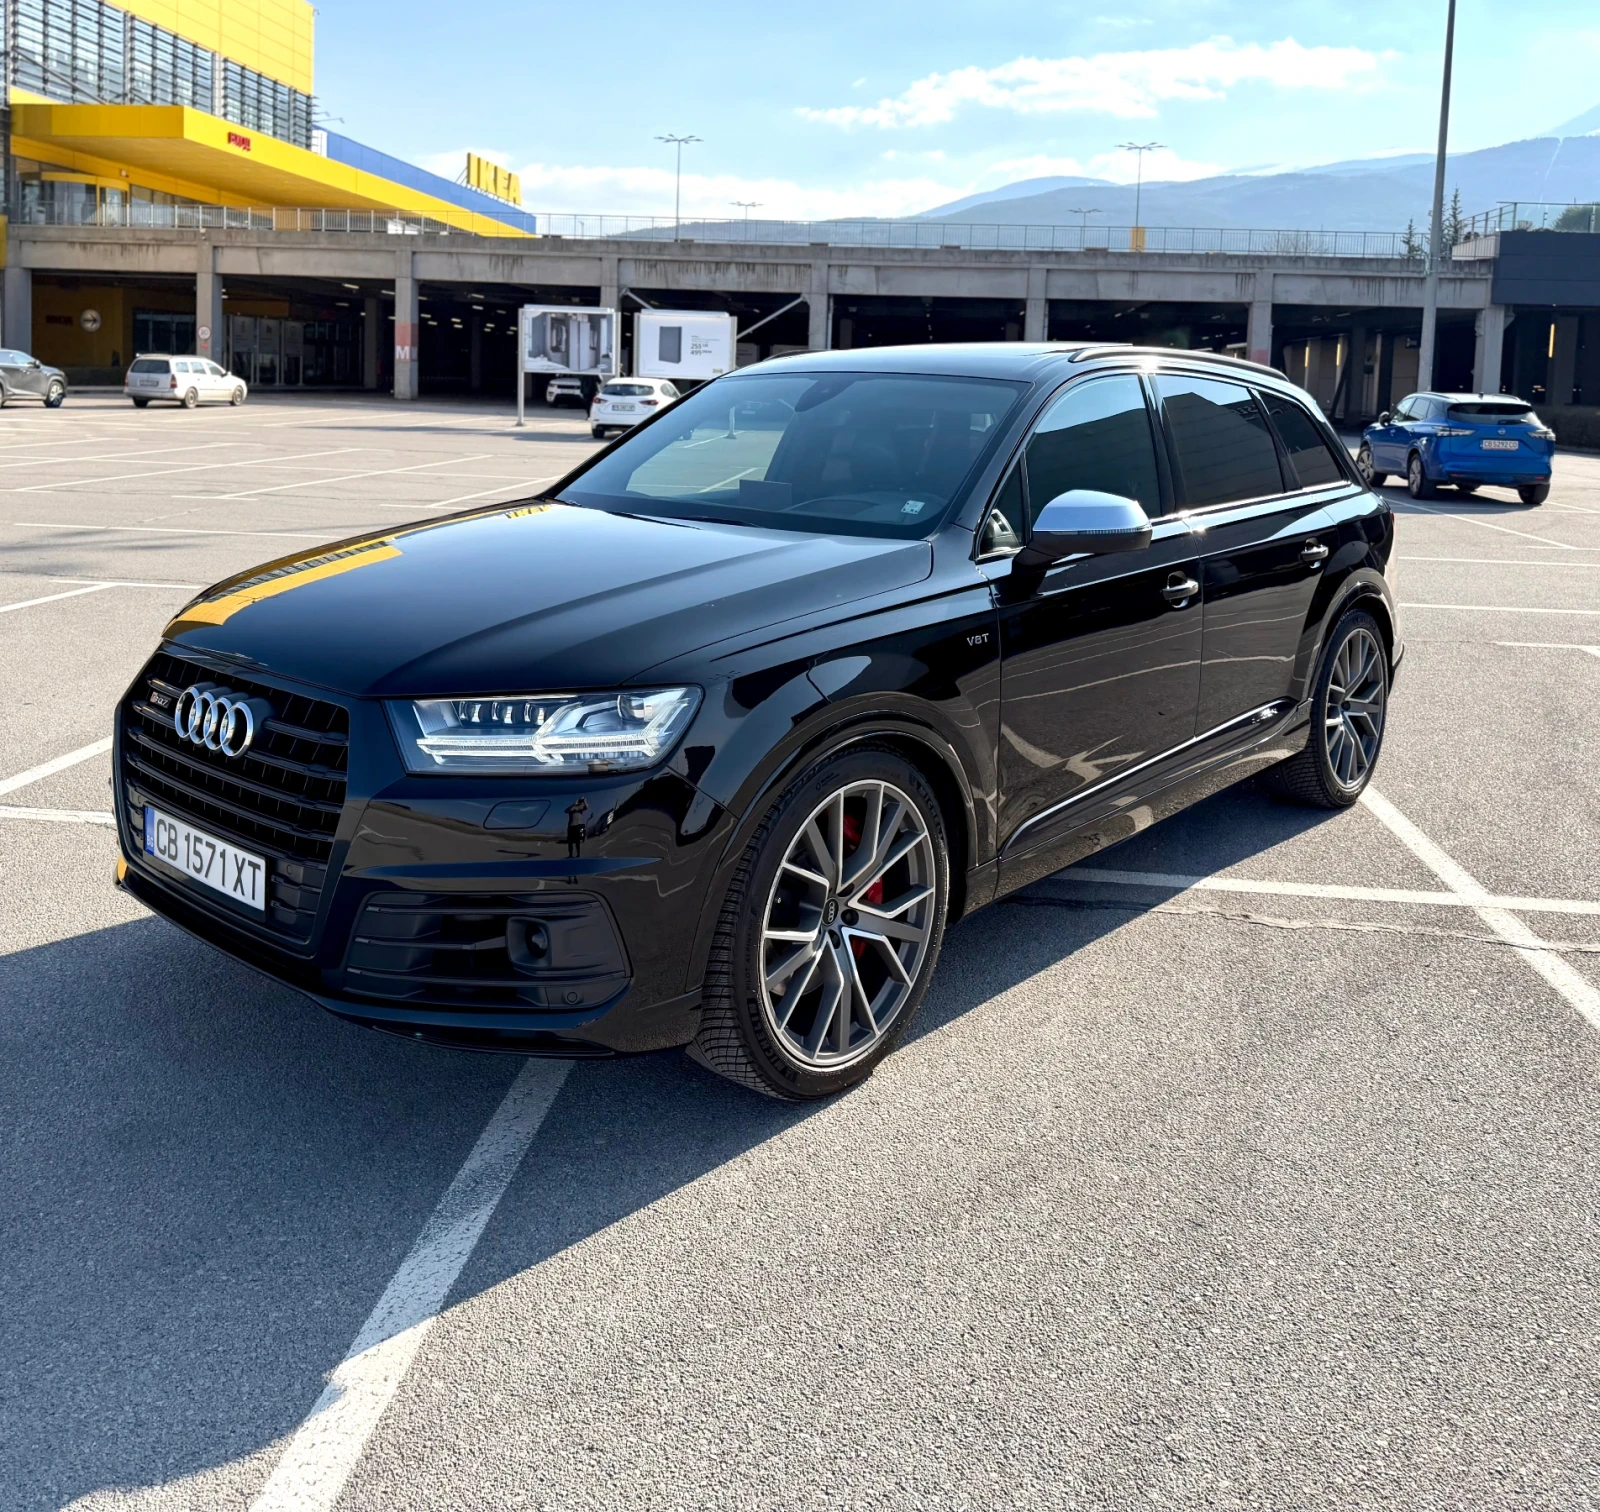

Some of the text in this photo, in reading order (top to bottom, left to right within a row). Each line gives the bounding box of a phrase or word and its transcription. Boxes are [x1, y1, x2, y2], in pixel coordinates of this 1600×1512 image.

[467, 152, 522, 206] IKEA
[966, 632, 990, 647] V8T
[156, 818, 262, 901] CB 1571 XT
[747, 1002, 785, 1073] MICHELIN
